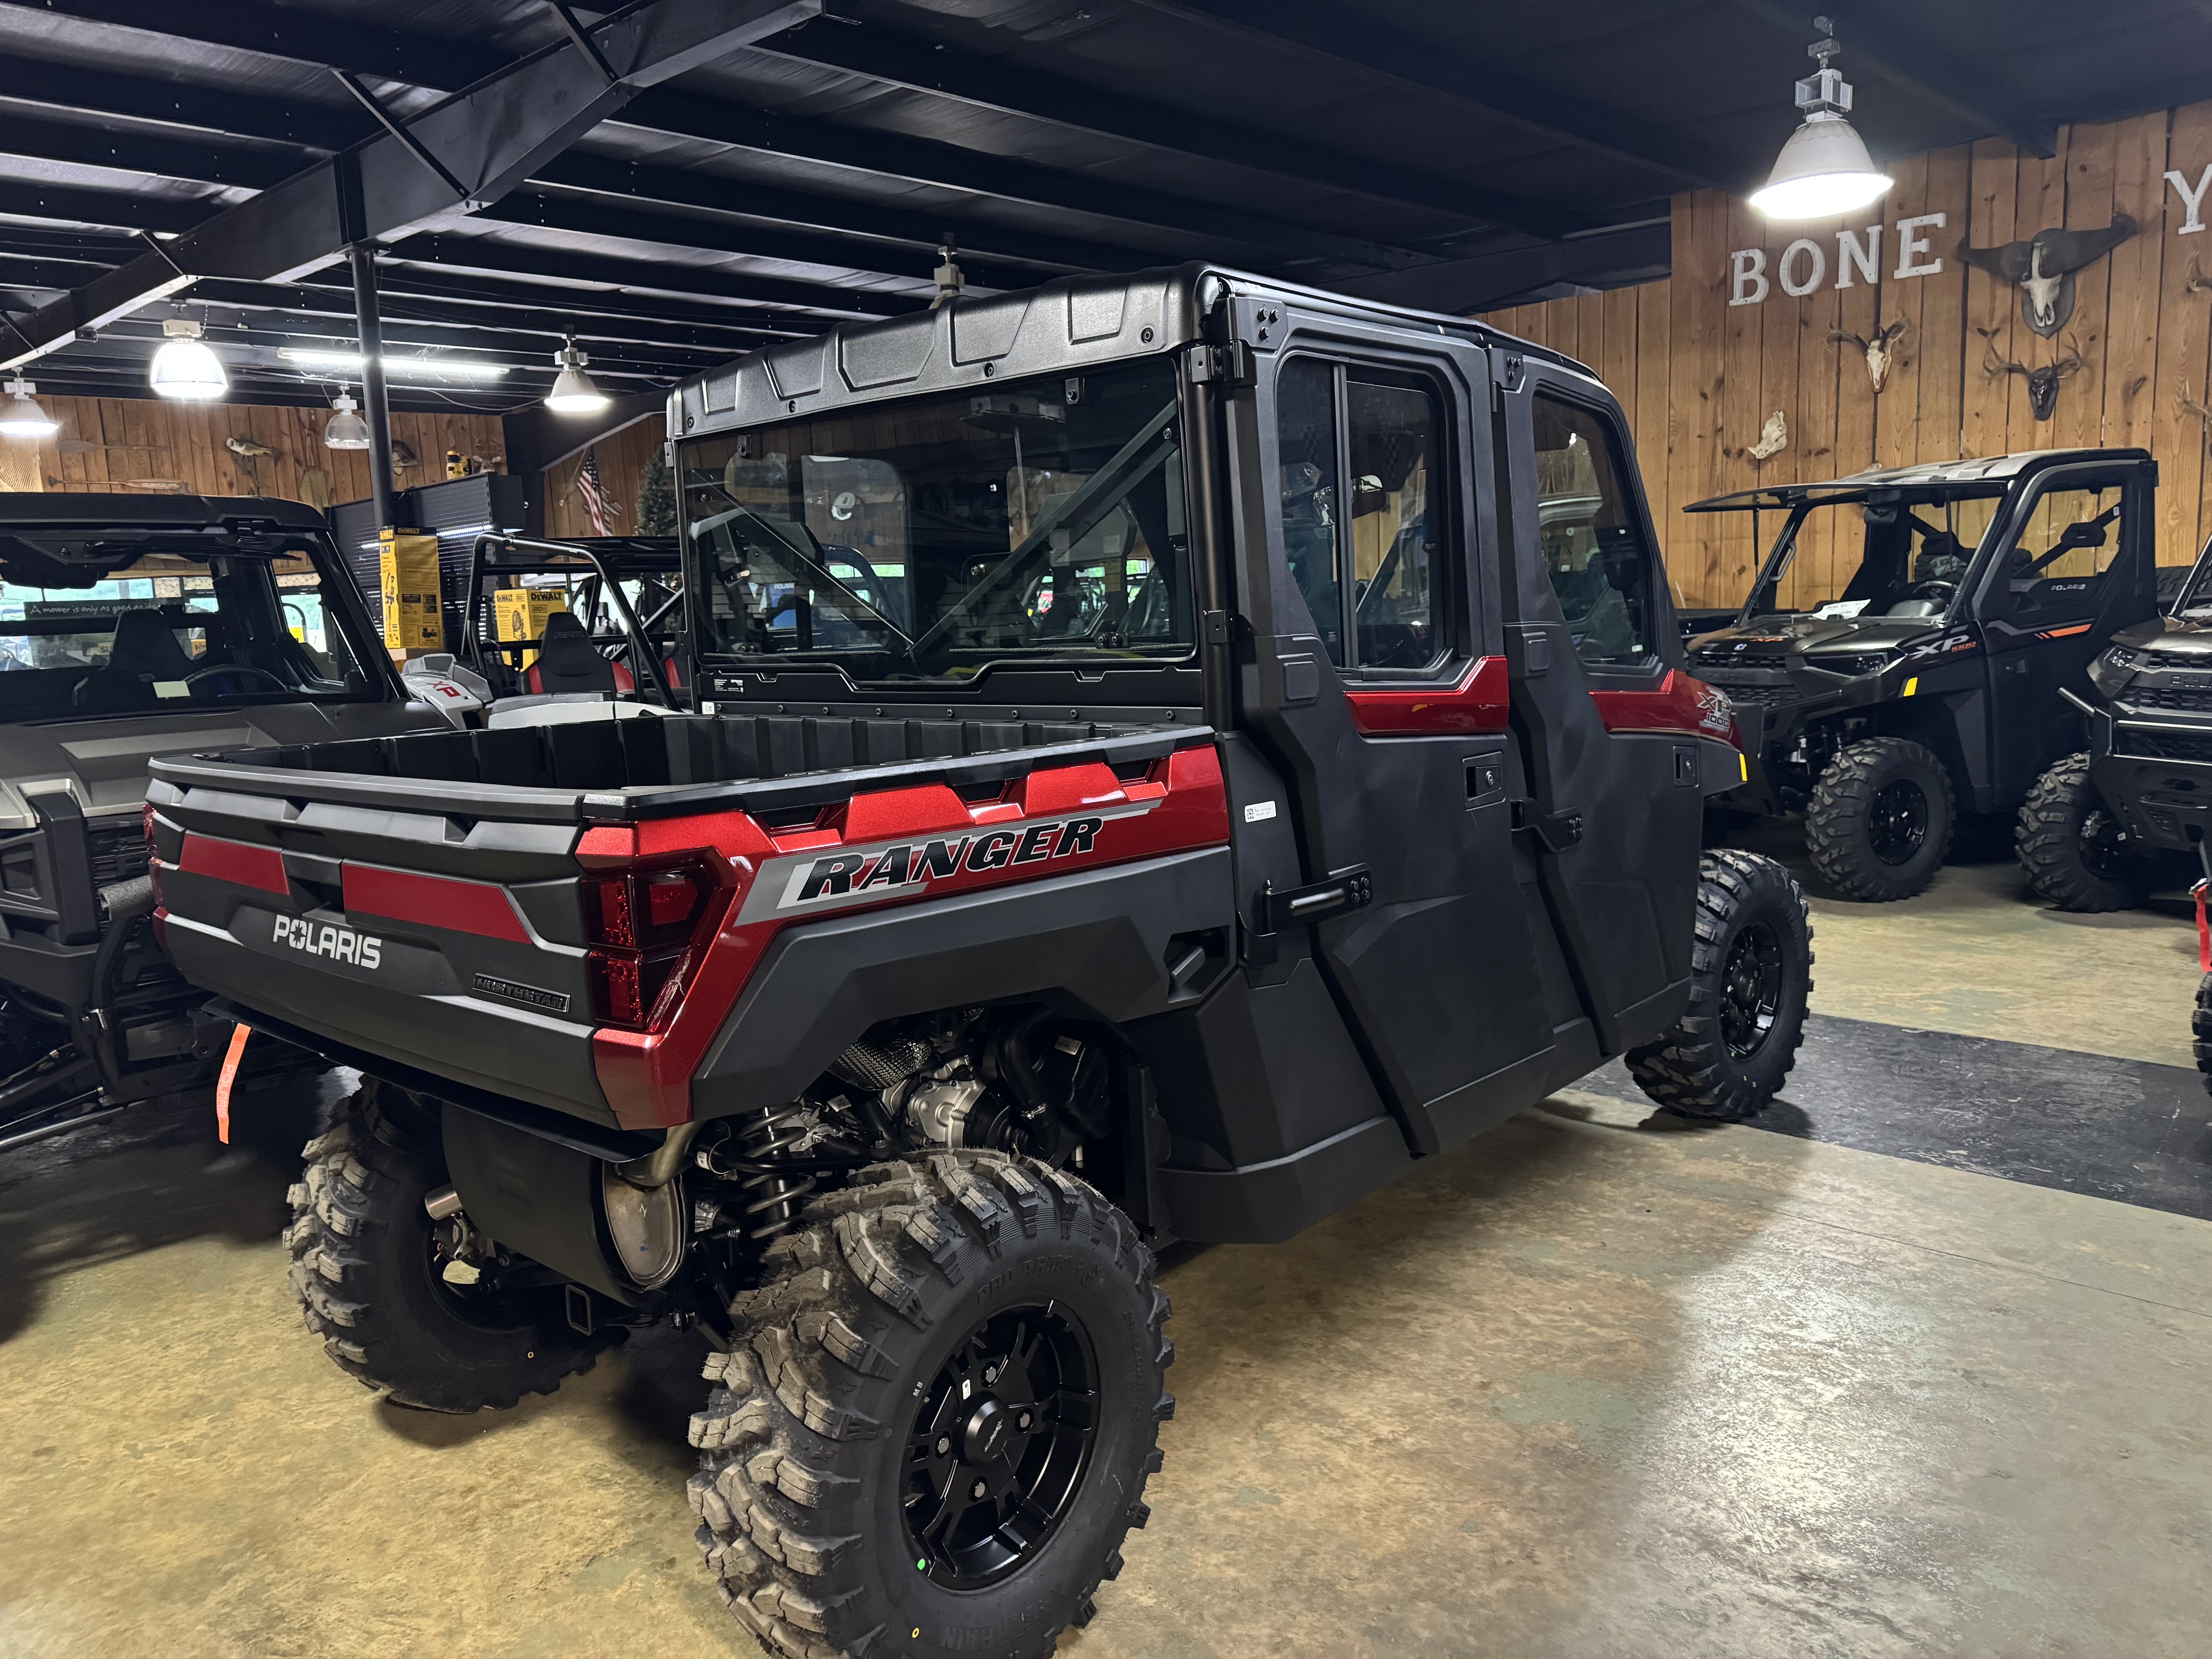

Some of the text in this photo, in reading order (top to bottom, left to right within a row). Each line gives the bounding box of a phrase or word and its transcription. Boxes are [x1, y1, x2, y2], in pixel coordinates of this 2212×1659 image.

[1729, 213, 1946, 307] BONE
[30, 605, 41, 614] A
[81, 604, 98, 615] only
[1910, 635, 1970, 659] XP
[426, 681, 462, 697] XP
[1697, 692, 1731, 713] XP
[796, 816, 1104, 902] RANGER
[273, 914, 382, 969] POLARIS
[476, 977, 563, 1008] NORTHSTAR
[218, 1064, 235, 1118] POLARIS
